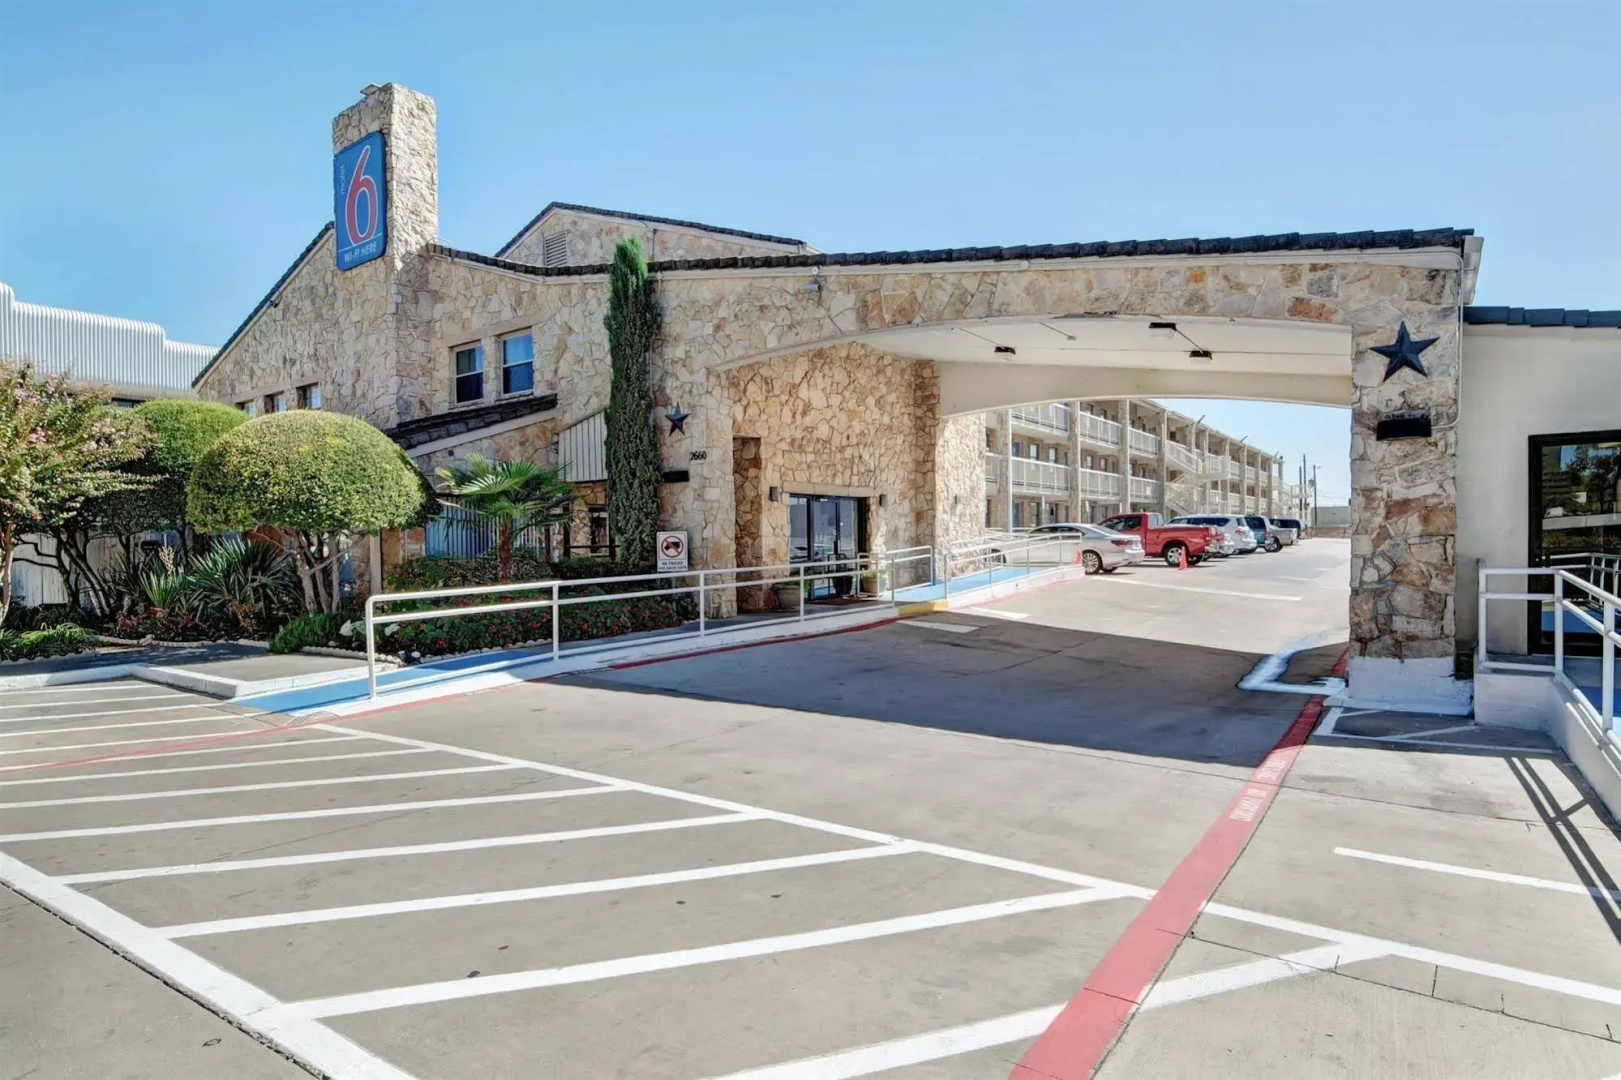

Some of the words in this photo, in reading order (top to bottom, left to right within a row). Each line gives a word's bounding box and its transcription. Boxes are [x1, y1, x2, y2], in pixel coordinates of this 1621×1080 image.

[345, 145, 378, 245] 6
[361, 241, 377, 256] HERE
[690, 450, 707, 460] 2660
